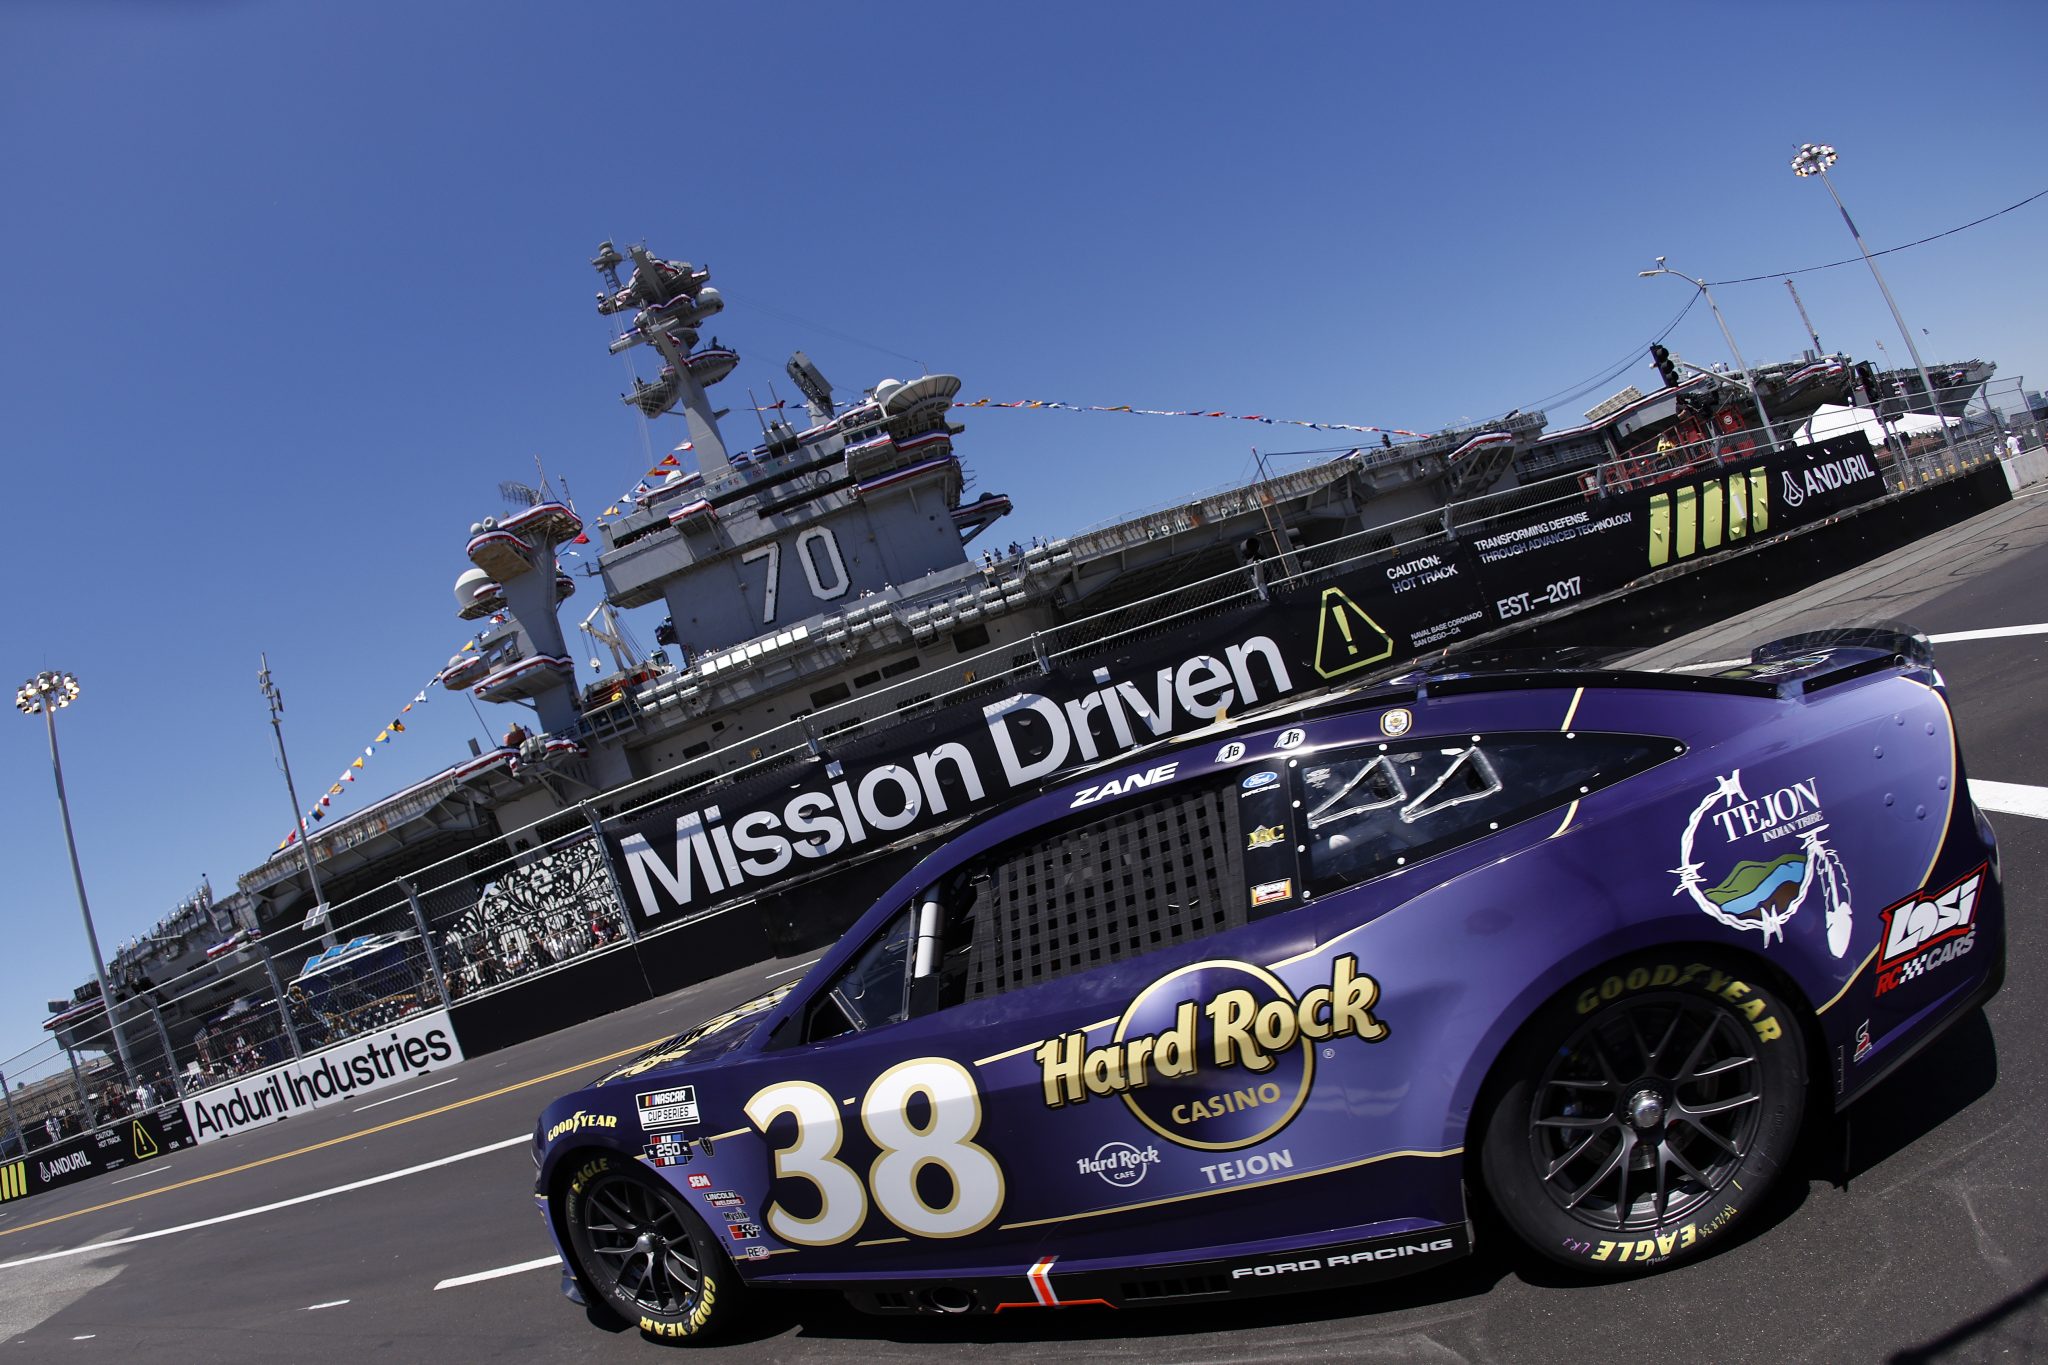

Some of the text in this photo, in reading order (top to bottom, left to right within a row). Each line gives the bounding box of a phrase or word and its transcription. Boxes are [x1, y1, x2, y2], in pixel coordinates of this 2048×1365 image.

[1805, 455, 1875, 497] ANDURIL
[1474, 511, 1589, 552] TRANSFORMING DEFENSE
[1479, 511, 1633, 564] THROUGH ADVANCED TECHNOLOGY
[742, 525, 851, 624] 70
[1386, 554, 1441, 580] CAUTION:
[1392, 564, 1458, 594] HOT TRACK
[1411, 610, 1483, 641] NAVAL BASE CORONADO
[1413, 636, 1427, 648] SAN
[619, 635, 1293, 917] Mission Driven
[1069, 761, 1180, 809] ZANE
[1712, 777, 1821, 843] TEJON
[1762, 821, 1796, 843] INDIAN
[1874, 931, 1977, 998] RC CARS
[1575, 963, 1783, 1044] GOODYEAR
[1035, 953, 1390, 1109] Hard Rock
[194, 1074, 289, 1138] Anduril
[283, 1029, 452, 1108] Industries
[654, 1090, 686, 1106] NASCAR
[648, 1106, 689, 1121] CUP SERIES
[1171, 1082, 1281, 1125] CASINO
[547, 1110, 617, 1142] GOODYEAR
[50, 1150, 92, 1177] ANDURIL
[656, 1142, 681, 1157] 250
[743, 1057, 1006, 1247] 38
[1076, 1145, 1161, 1175] Hard Rock
[1200, 1149, 1294, 1184] TEJON
[571, 1158, 609, 1195] EAGLE
[688, 1175, 711, 1188] SEM
[1114, 1170, 1136, 1180] CAFE
[704, 1191, 736, 1201] LINCOLN
[1231, 1238, 1454, 1279] FORD RACING
[1590, 1222, 1701, 1263] EAGLE
[639, 1275, 717, 1337] GOODYEAR
